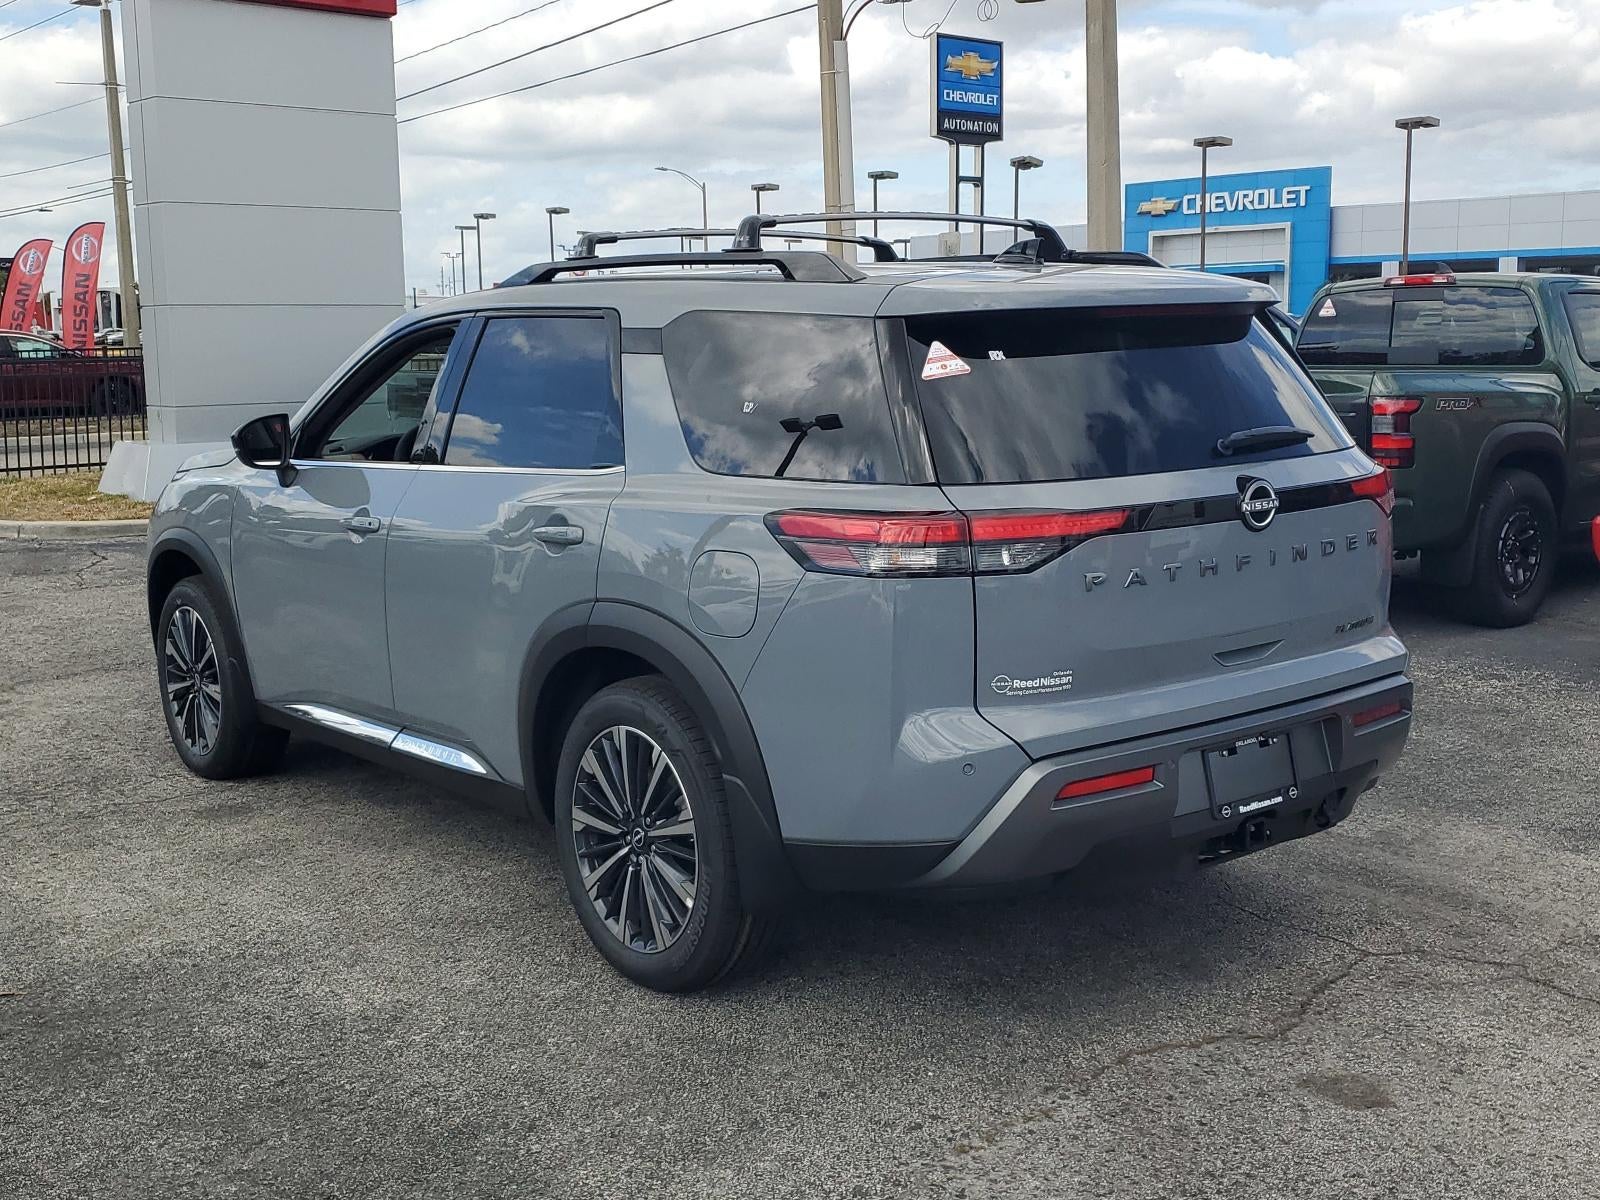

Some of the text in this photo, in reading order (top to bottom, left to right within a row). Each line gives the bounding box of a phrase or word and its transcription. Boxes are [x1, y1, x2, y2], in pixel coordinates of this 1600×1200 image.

[943, 89, 998, 106] CHEVROLET
[943, 118, 999, 133] AUTONATION
[1182, 186, 1311, 215] CHEVROLET
[73, 272, 91, 348] NISSAN
[1243, 499, 1279, 511] NISSAN
[1083, 528, 1378, 592] PATHFINDER
